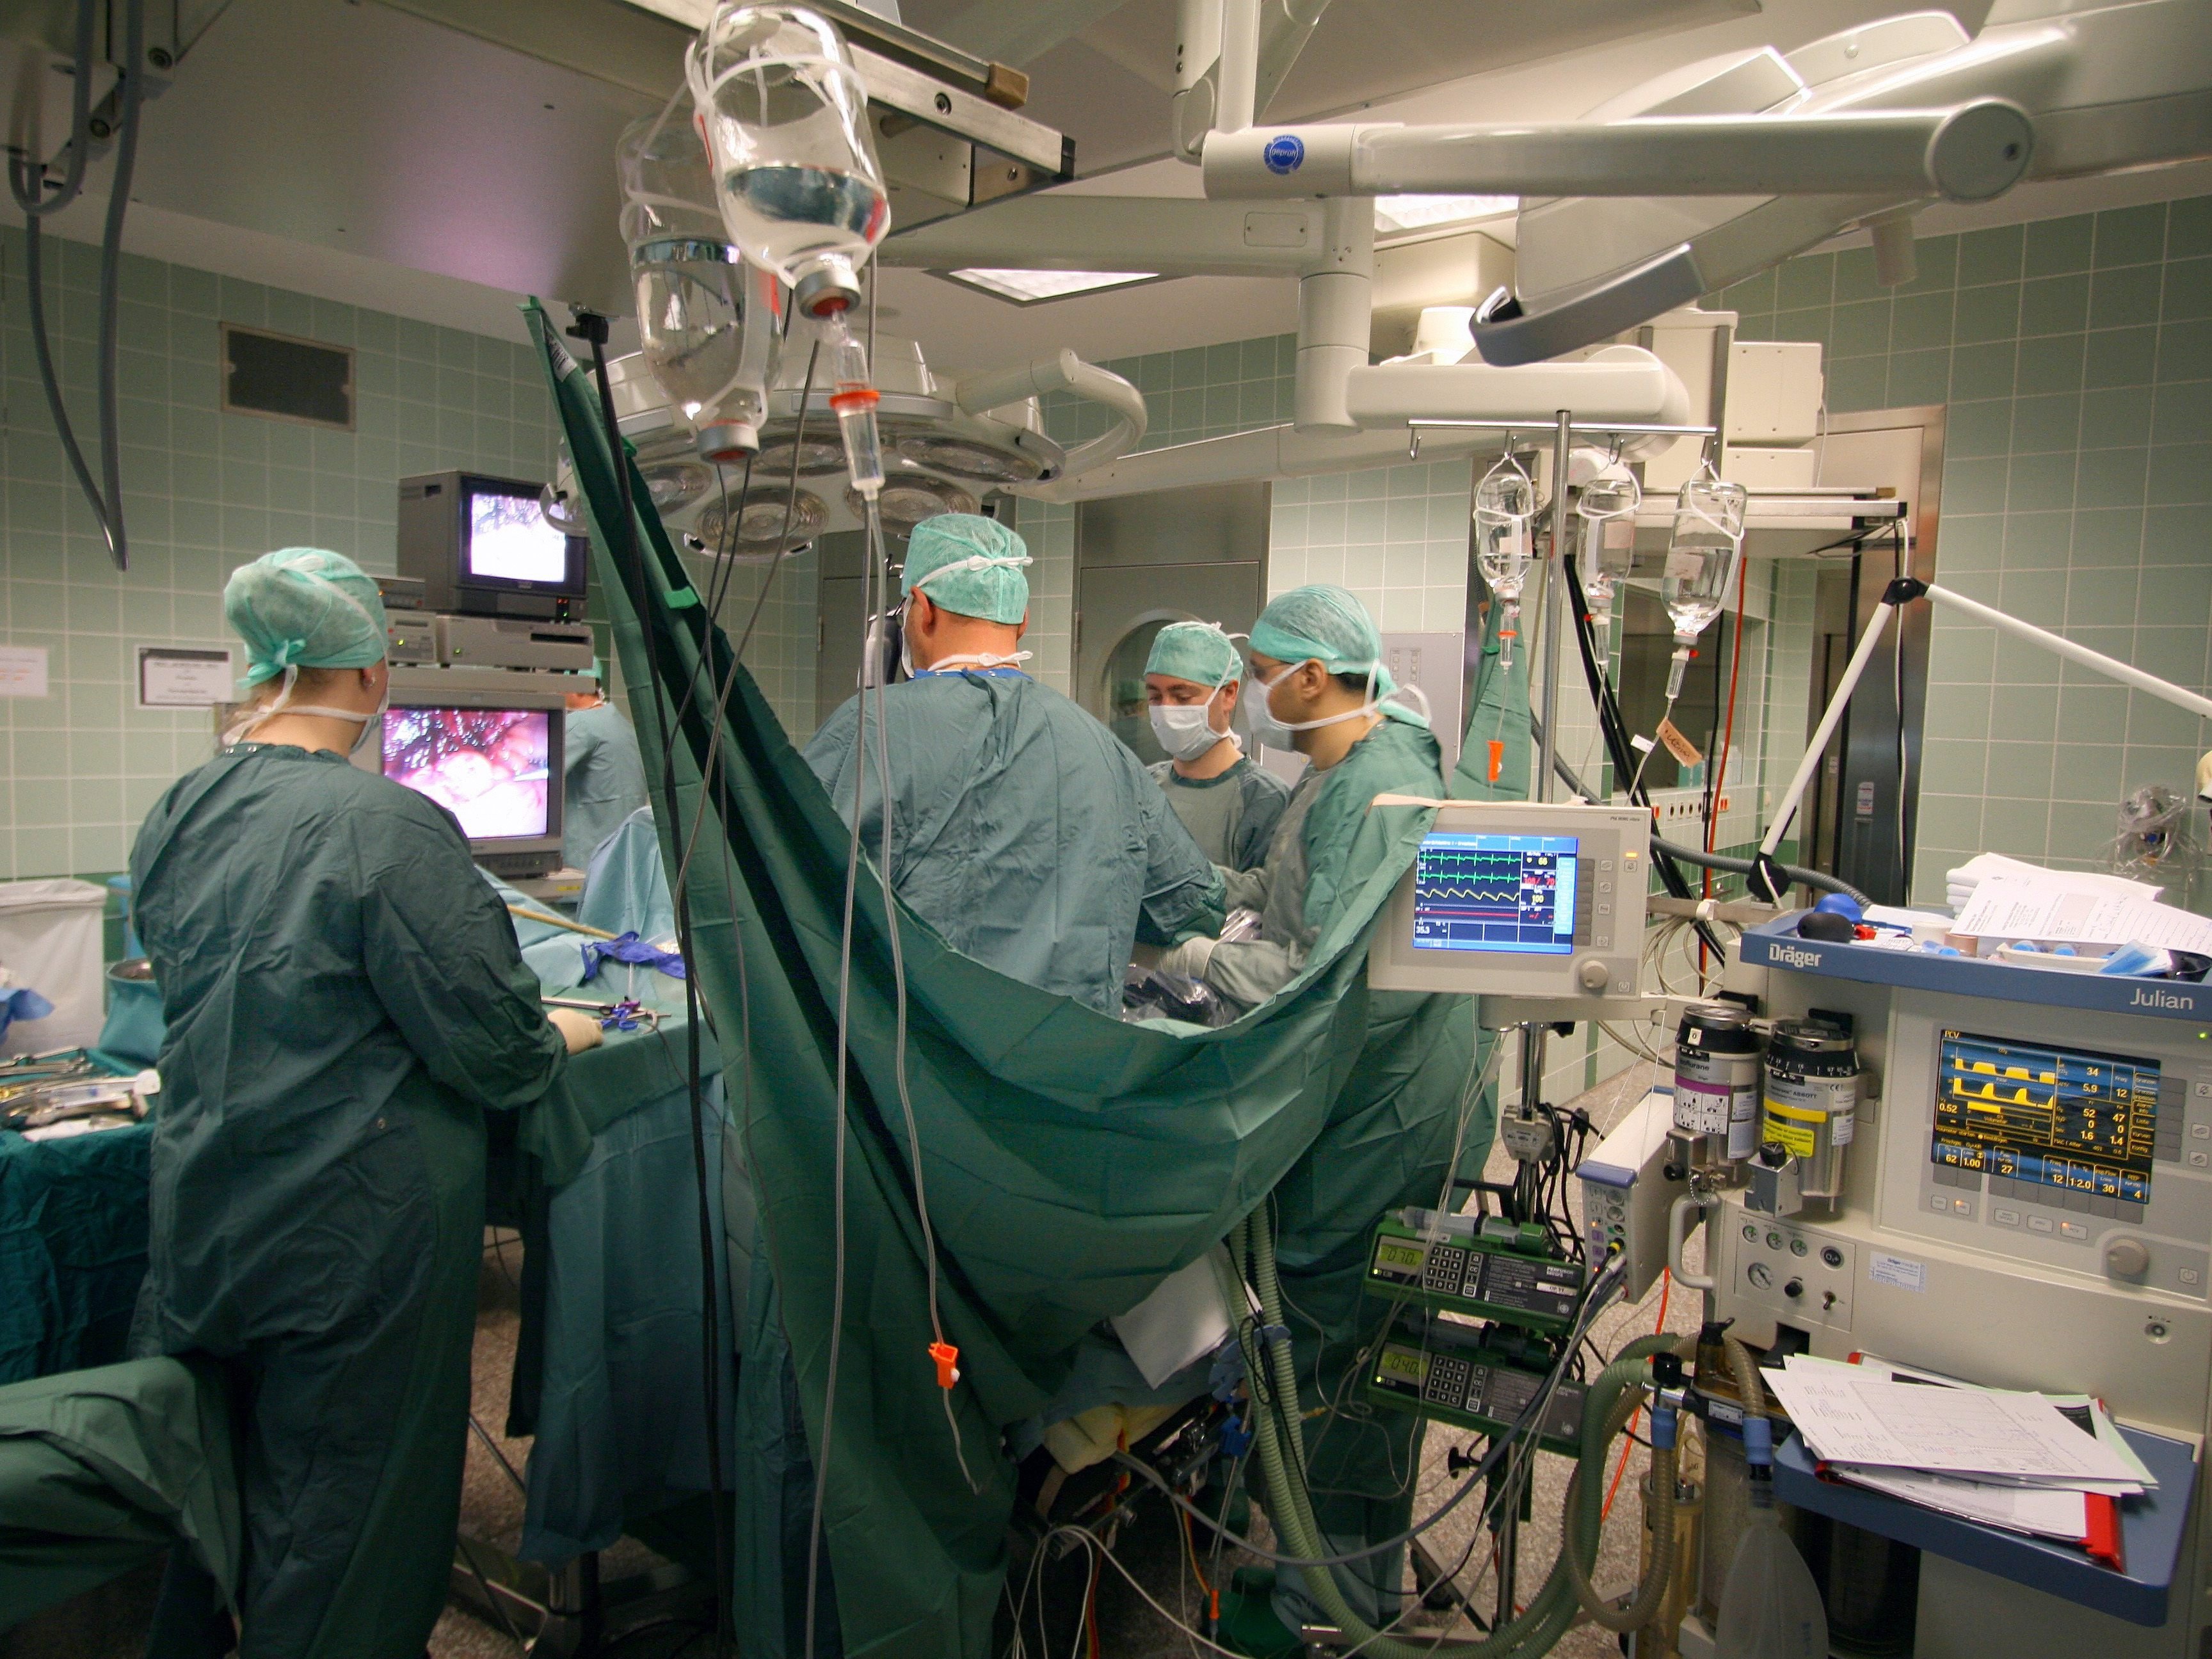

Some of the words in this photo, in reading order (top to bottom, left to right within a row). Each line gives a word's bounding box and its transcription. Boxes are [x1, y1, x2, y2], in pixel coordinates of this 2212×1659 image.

[1768, 943, 1822, 968] Dräger
[2130, 988, 2193, 1011] Julian
[1944, 1030, 1960, 1039] PCV
[2087, 1067, 2099, 1077] 34
[2083, 1083, 2097, 1093] 5.9
[2116, 1088, 2128, 1098] 12
[1939, 1103, 1957, 1114] 0.52
[2083, 1108, 2096, 1118] 52
[2113, 1114, 2126, 1123] 47
[2088, 1120, 2094, 1129] 0
[2117, 1125, 2124, 1134] 0
[2081, 1130, 2094, 1141] 1.6
[2110, 1135, 2124, 1146] 1.4
[1946, 1154, 1957, 1164] 62
[1964, 1158, 1980, 1168] 1.00
[2001, 1166, 2013, 1174] 27
[2053, 1174, 2064, 1184] 12
[2070, 1177, 2092, 1189] 1:2.0
[2102, 1184, 2115, 1194] 30
[2134, 1190, 2141, 1199] 4
